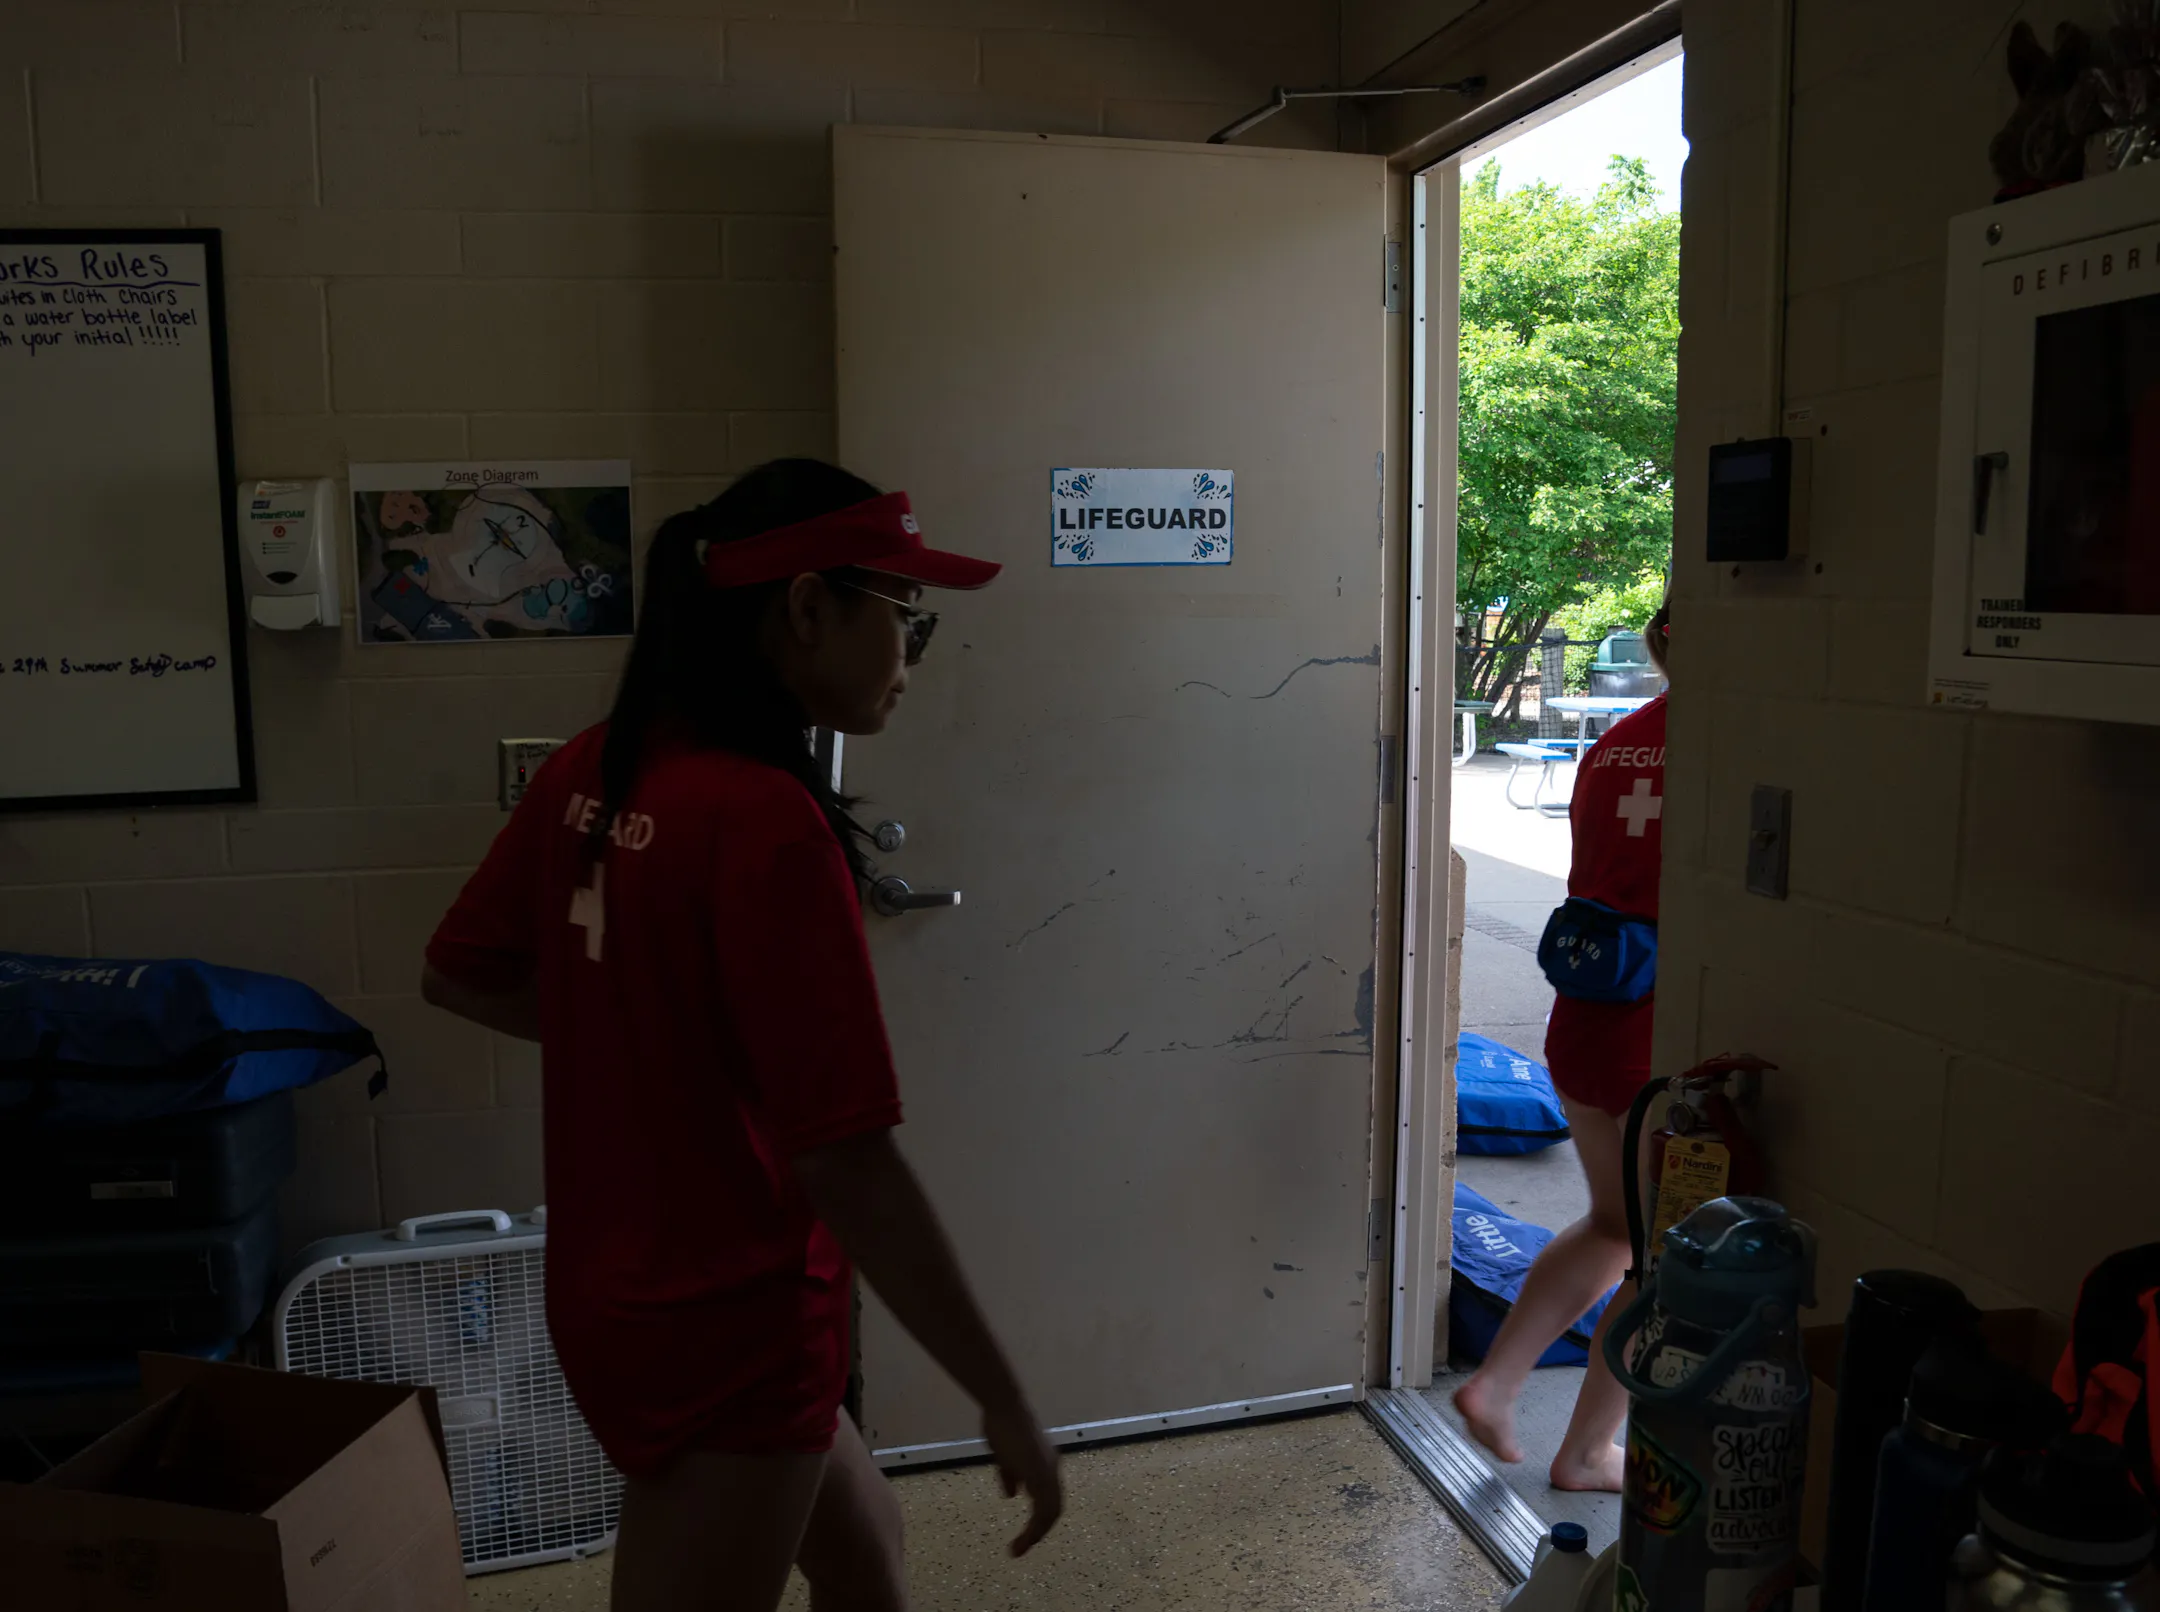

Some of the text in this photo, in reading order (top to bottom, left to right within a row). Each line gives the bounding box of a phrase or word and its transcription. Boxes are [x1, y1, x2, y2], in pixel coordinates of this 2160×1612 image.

[80, 248, 169, 281] Rules
[41, 290, 56, 304] in
[3, 308, 198, 326] a water bottle label
[21, 331, 63, 357] your
[445, 468, 539, 484] Zone Diagram
[1059, 507, 1227, 530] LIFEGUARD
[1980, 598, 2025, 612] TRAINED
[1976, 615, 2042, 631] RESPONDERS
[1995, 634, 2020, 648] ONLY
[1682, 1157, 1724, 1172] Nardini
[1465, 1214, 1523, 1259] Little
